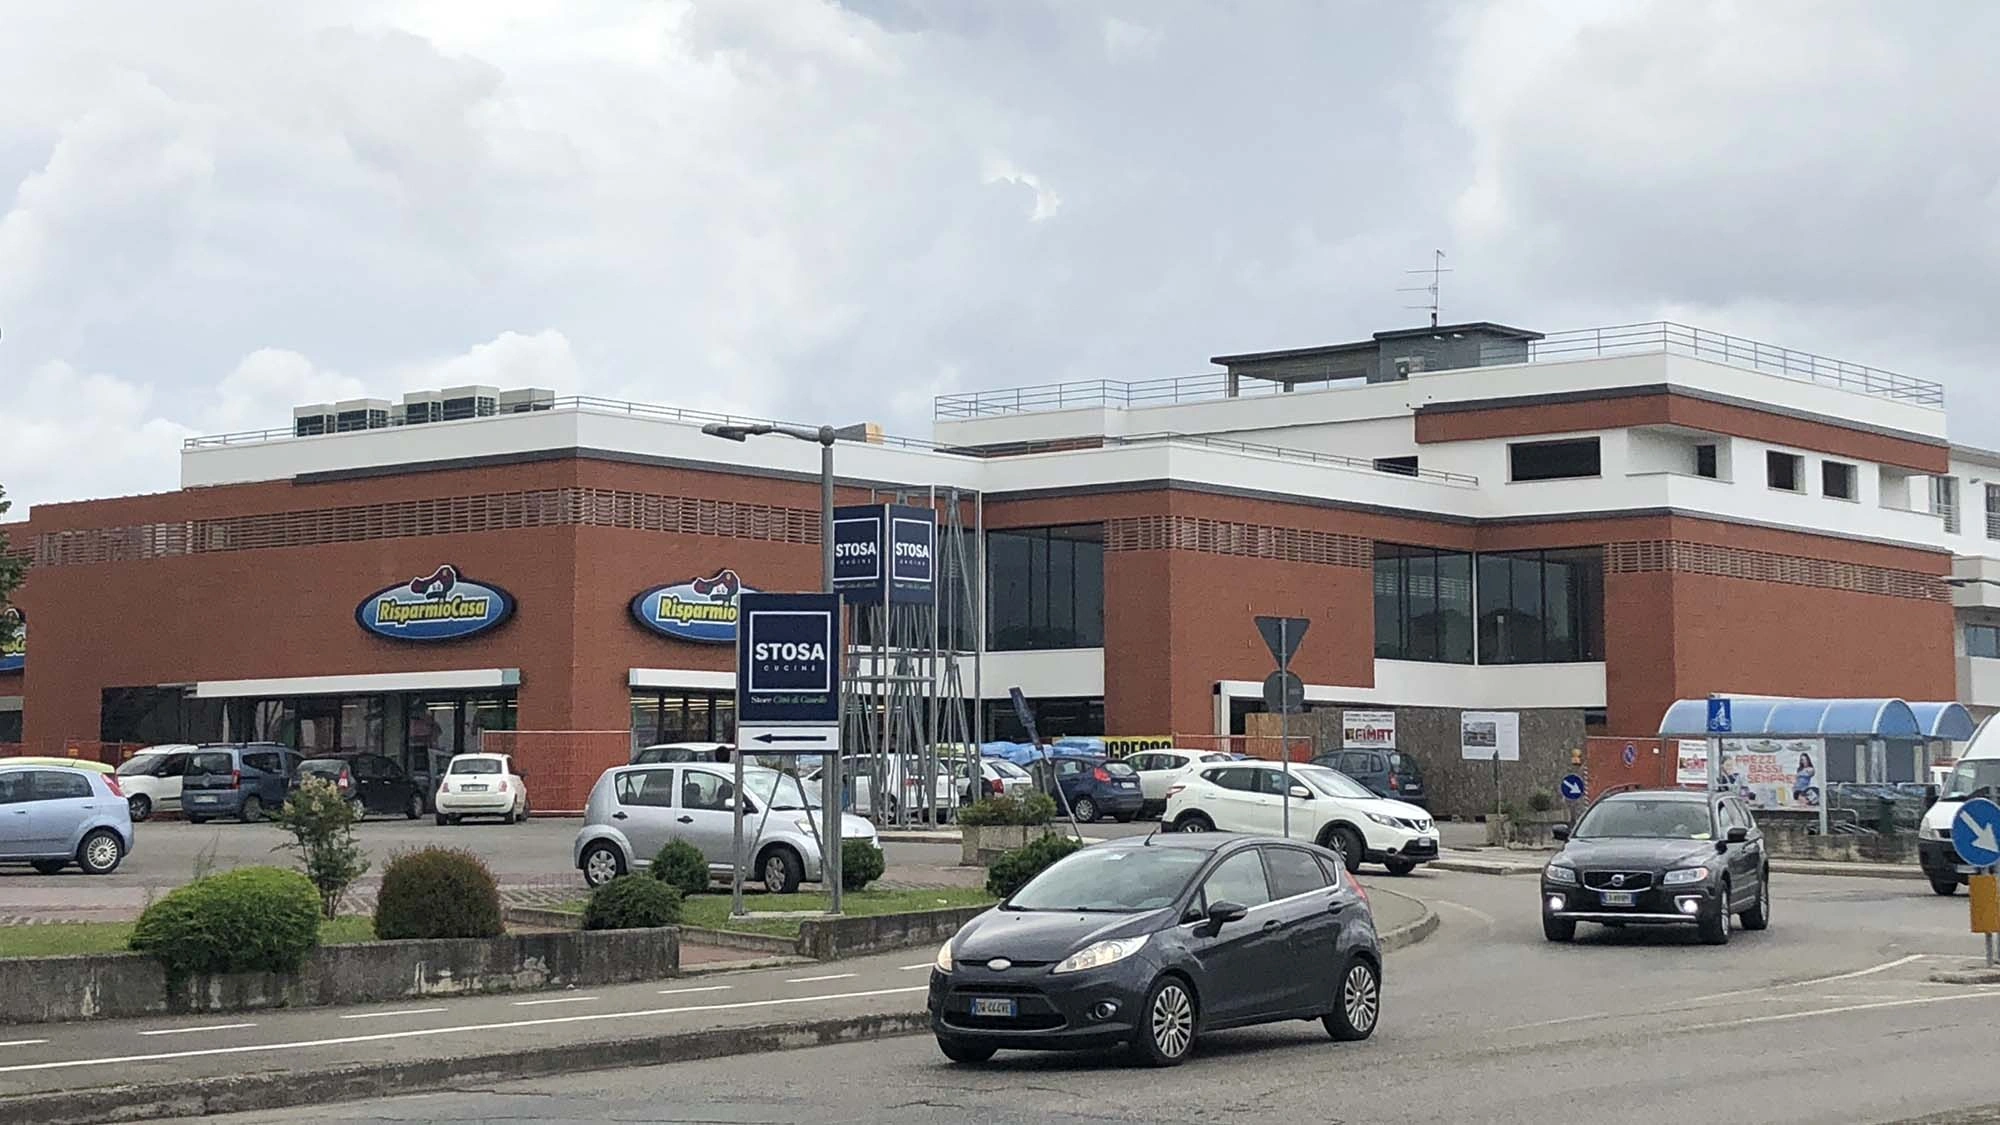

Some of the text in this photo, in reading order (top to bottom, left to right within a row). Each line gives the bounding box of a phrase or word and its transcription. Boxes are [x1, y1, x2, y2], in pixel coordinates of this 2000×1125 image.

[835, 542, 877, 558] STOSA
[895, 542, 929, 558] STOSA
[379, 597, 486, 622] RisparmioCasa
[755, 642, 825, 661] STOSA
